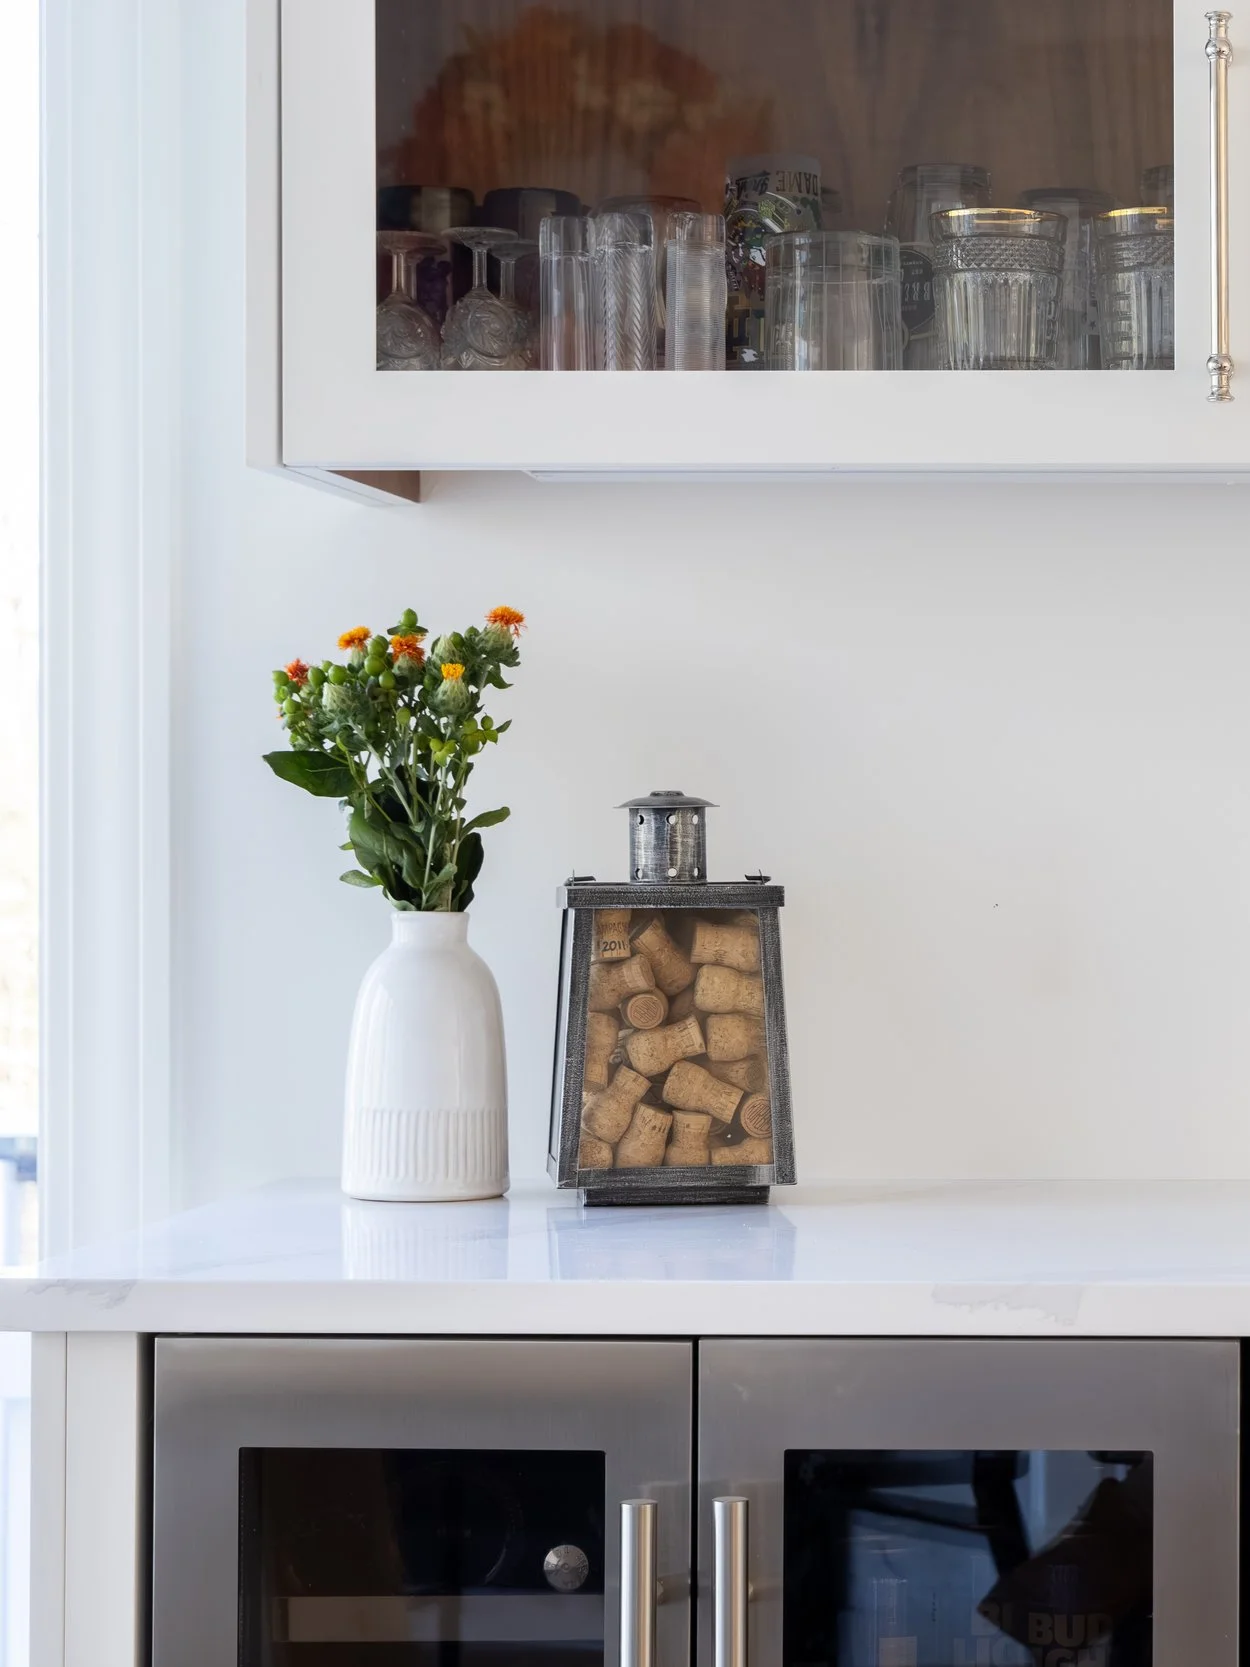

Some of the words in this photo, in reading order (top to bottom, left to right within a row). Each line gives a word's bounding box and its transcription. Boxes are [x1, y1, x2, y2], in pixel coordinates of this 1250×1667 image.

[775, 170, 819, 197] DAME
[602, 939, 625, 952] 2011
[1028, 1612, 1113, 1648] BUD
